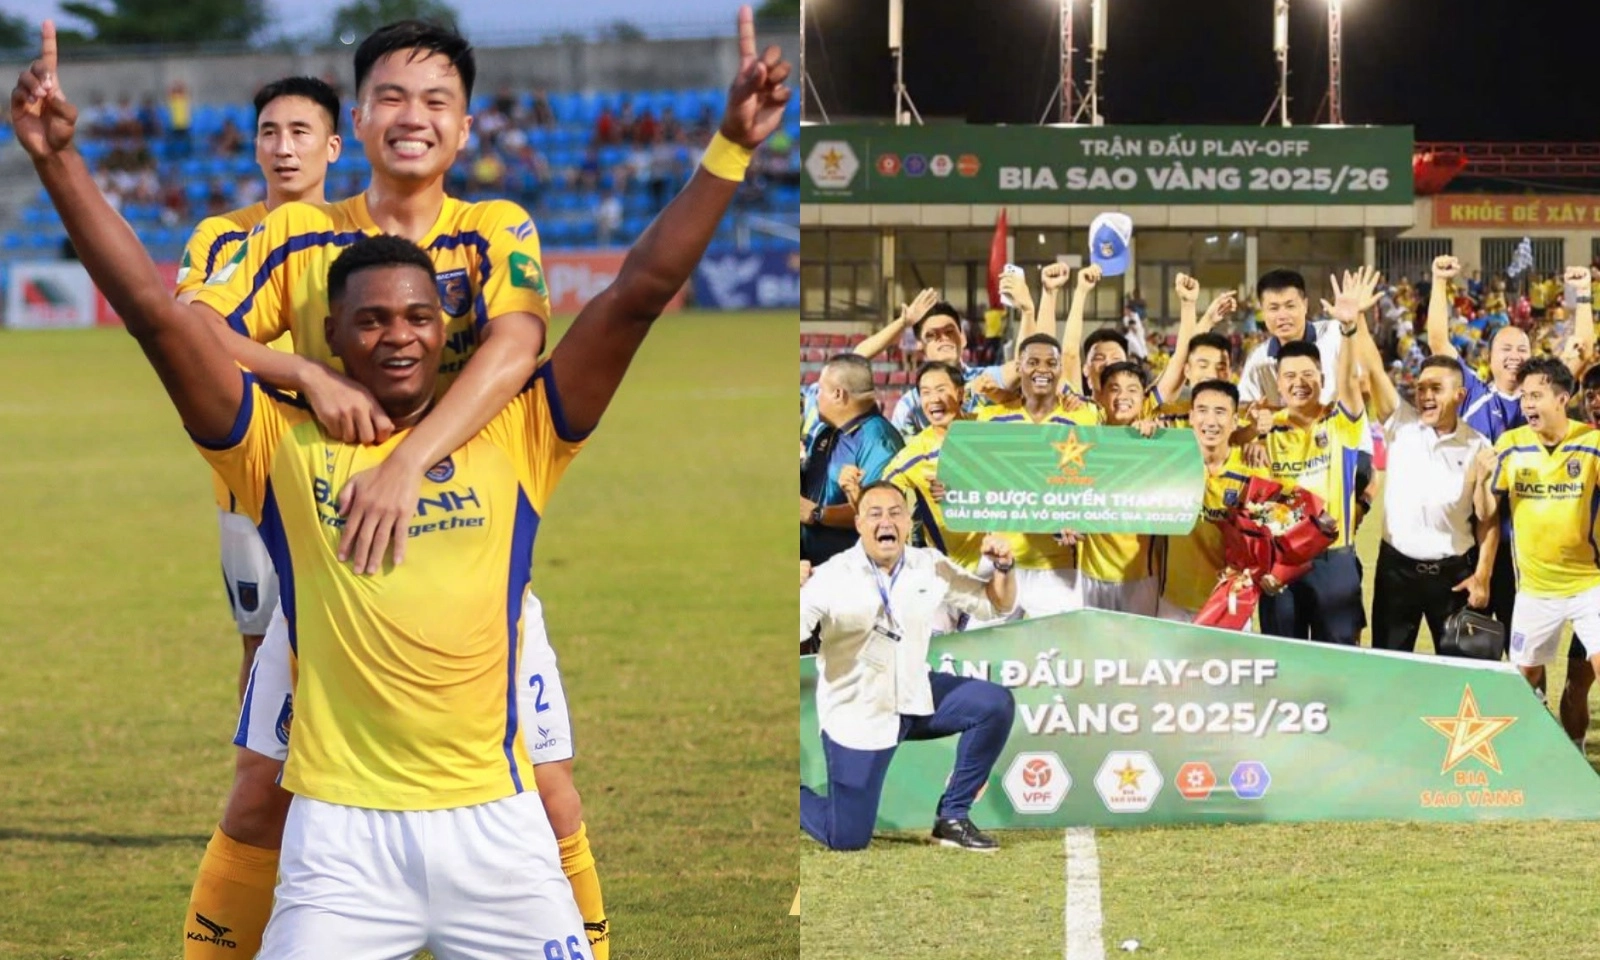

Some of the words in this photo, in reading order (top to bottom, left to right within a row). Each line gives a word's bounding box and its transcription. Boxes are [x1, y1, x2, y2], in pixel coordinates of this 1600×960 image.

[1080, 139, 1142, 160] TRẬN
[1147, 133, 1196, 157] ĐẤU
[1202, 139, 1309, 157] PLAY-OFF
[999, 167, 1058, 190] BIA
[1066, 167, 1138, 190] SAO
[1145, 163, 1241, 190] VÀNG
[1249, 166, 1389, 194] 2025/26
[1451, 200, 1504, 222] KHỎE
[1548, 203, 1588, 222] XÂY
[945, 490, 980, 504] CLB
[985, 490, 1037, 508] ĐƯỢC
[1001, 649, 1084, 687] ĐẤU
[1094, 659, 1277, 686] PLAY-OFF
[529, 674, 549, 713] 2
[1020, 695, 1139, 734] VÀNG
[1151, 700, 1328, 736] 2025/26
[1455, 771, 1487, 785] BIA
[1023, 792, 1052, 802] VPF
[1420, 790, 1462, 807] SAO
[187, 932, 236, 948] KAMITO
